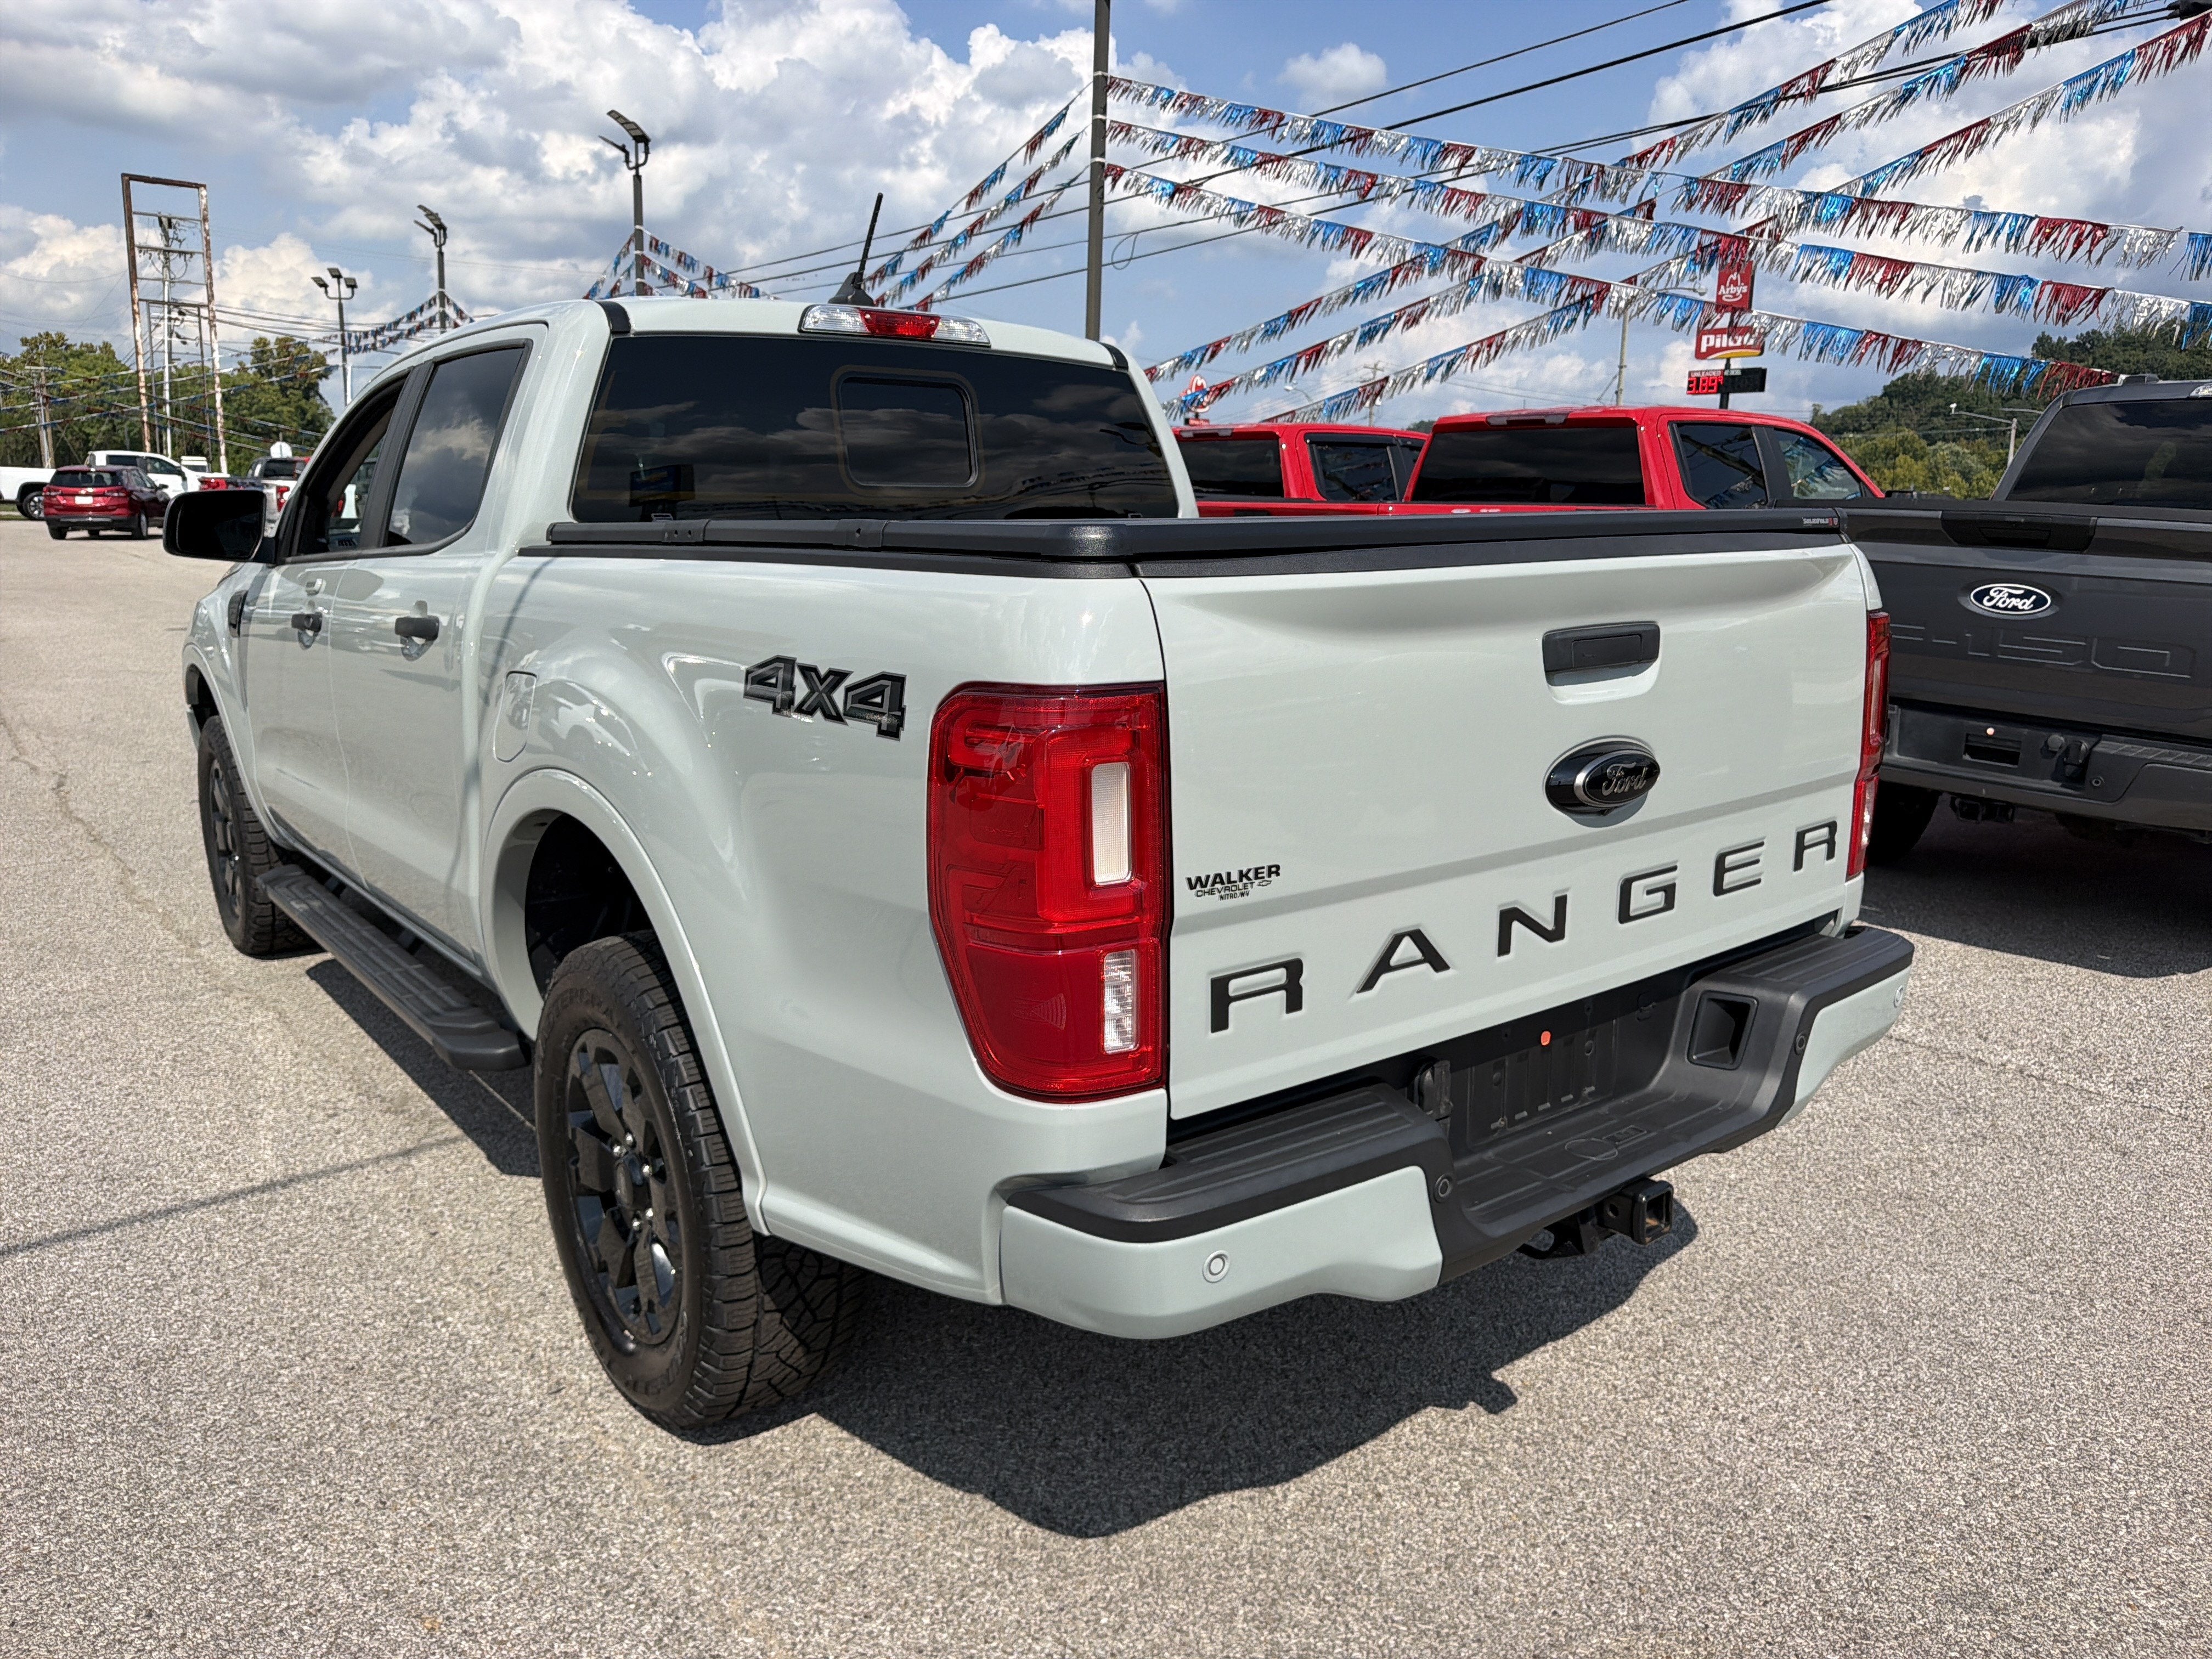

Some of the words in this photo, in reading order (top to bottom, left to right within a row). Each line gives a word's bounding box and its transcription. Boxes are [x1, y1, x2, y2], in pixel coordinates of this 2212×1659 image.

[1718, 283, 1748, 296] Arby's
[1983, 586, 2036, 612] Ford
[1601, 761, 1648, 796] Ford
[1186, 864, 1280, 890] WALKER
[1195, 882, 1255, 897] CHEVROLET
[1209, 819, 1838, 1034] RANGER
